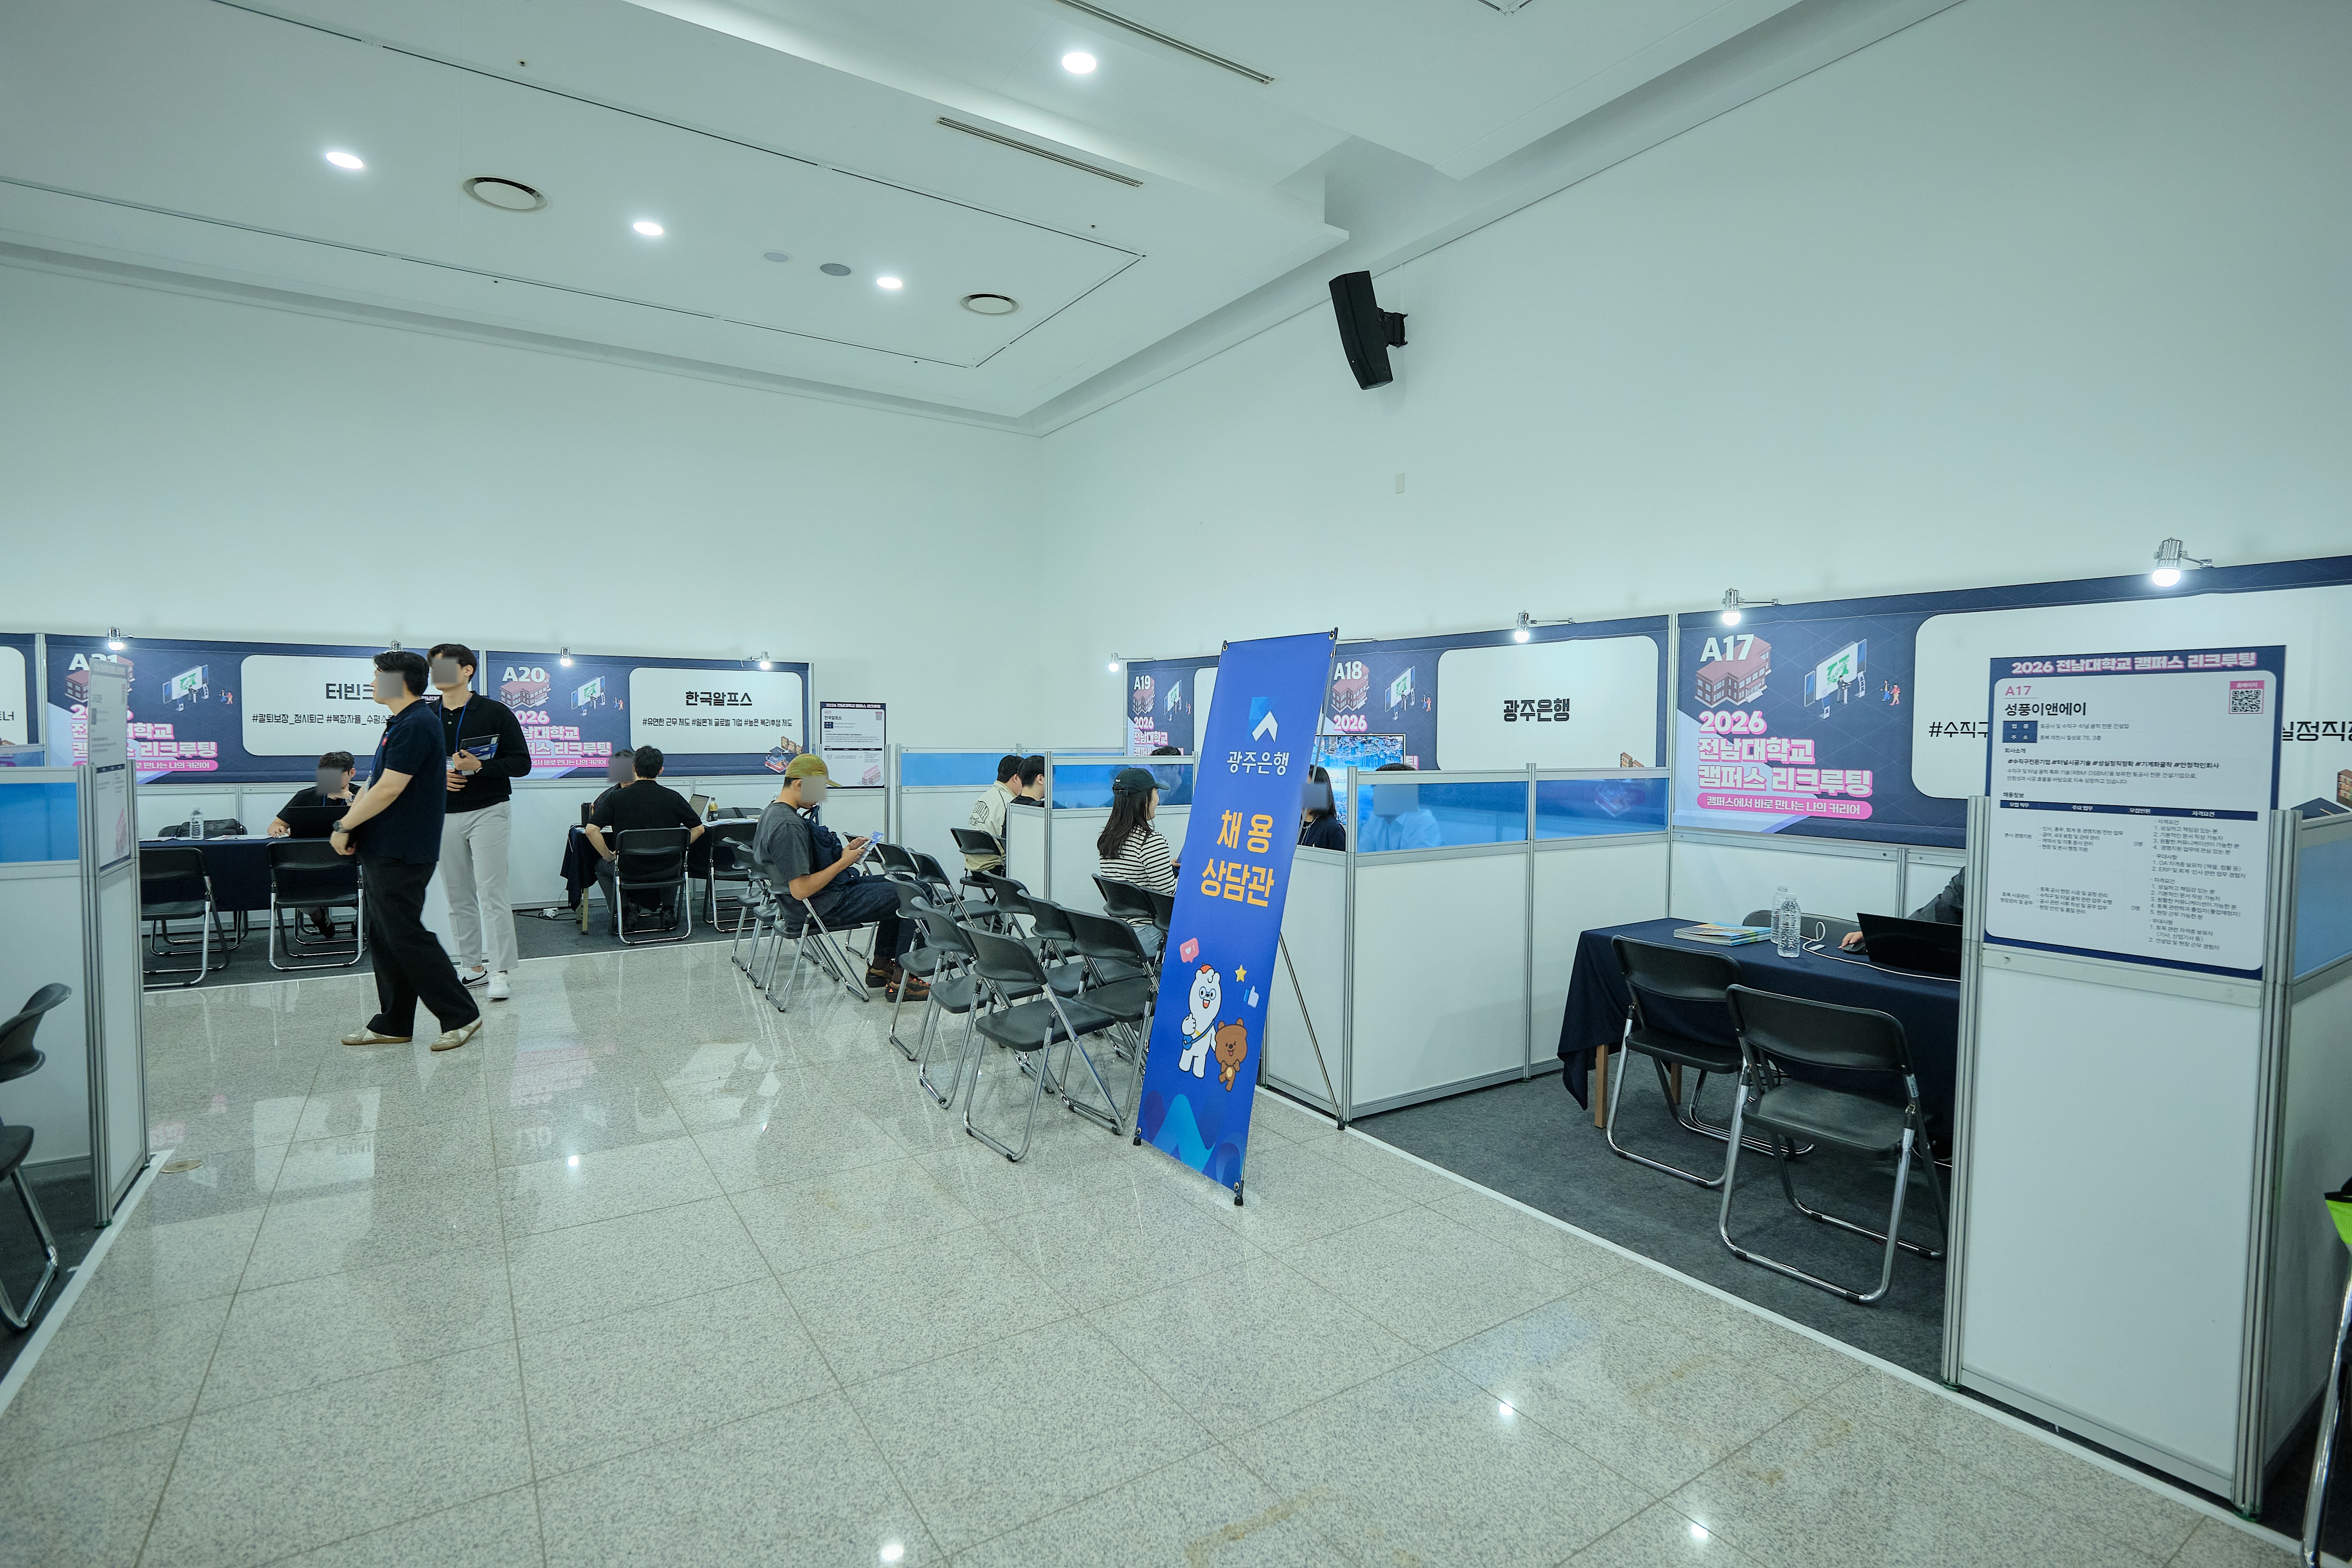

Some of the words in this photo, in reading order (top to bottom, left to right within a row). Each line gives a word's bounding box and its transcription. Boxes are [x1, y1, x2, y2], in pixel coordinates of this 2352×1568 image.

[1700, 634, 1754, 662] A17
[1334, 661, 1363, 680] A18
[2012, 661, 2054, 674] 2026
[2056, 658, 2132, 673] 전남대학교
[2134, 655, 2184, 670] 캠퍼스
[2187, 652, 2258, 668] 리크루팅
[502, 666, 545, 682] A20
[1133, 675, 1151, 690] A19
[2005, 686, 2031, 695] A17
[686, 691, 752, 706] 한국알프스
[514, 710, 550, 724] 026
[1504, 698, 1570, 722] 광주은행
[2005, 702, 2086, 716] 성풍이앤에이
[642, 718, 664, 726] #유연한
[666, 718, 677, 726] 근무
[679, 718, 690, 726] 제도
[691, 718, 713, 727] #일본계
[714, 719, 730, 727] 글로벌
[732, 719, 742, 727] 기업
[744, 719, 759, 727] #높은
[760, 719, 780, 727] 복리후생
[782, 719, 792, 727] 제도
[1134, 716, 1154, 730] 2026
[1334, 715, 1368, 731] 2026
[1699, 710, 1767, 734] 2026
[521, 726, 580, 740] 남대학교
[1134, 731, 1168, 745] 전남대학교
[139, 742, 218, 758] 리크루팅
[554, 742, 612, 756] 리크루팅
[1698, 737, 1815, 764] 전남대학교
[1227, 751, 1290, 776] 광주은행
[1698, 765, 1767, 791] 캠퍼스
[1771, 767, 1873, 798] 리크루팅
[1707, 796, 1752, 808] 캠퍼스에서
[1754, 798, 1773, 809] 바로
[1775, 799, 1804, 811] 만나는
[1806, 800, 1826, 813] 나의
[1829, 802, 1860, 815] 커리어
[1201, 858, 1274, 907] 상담관
